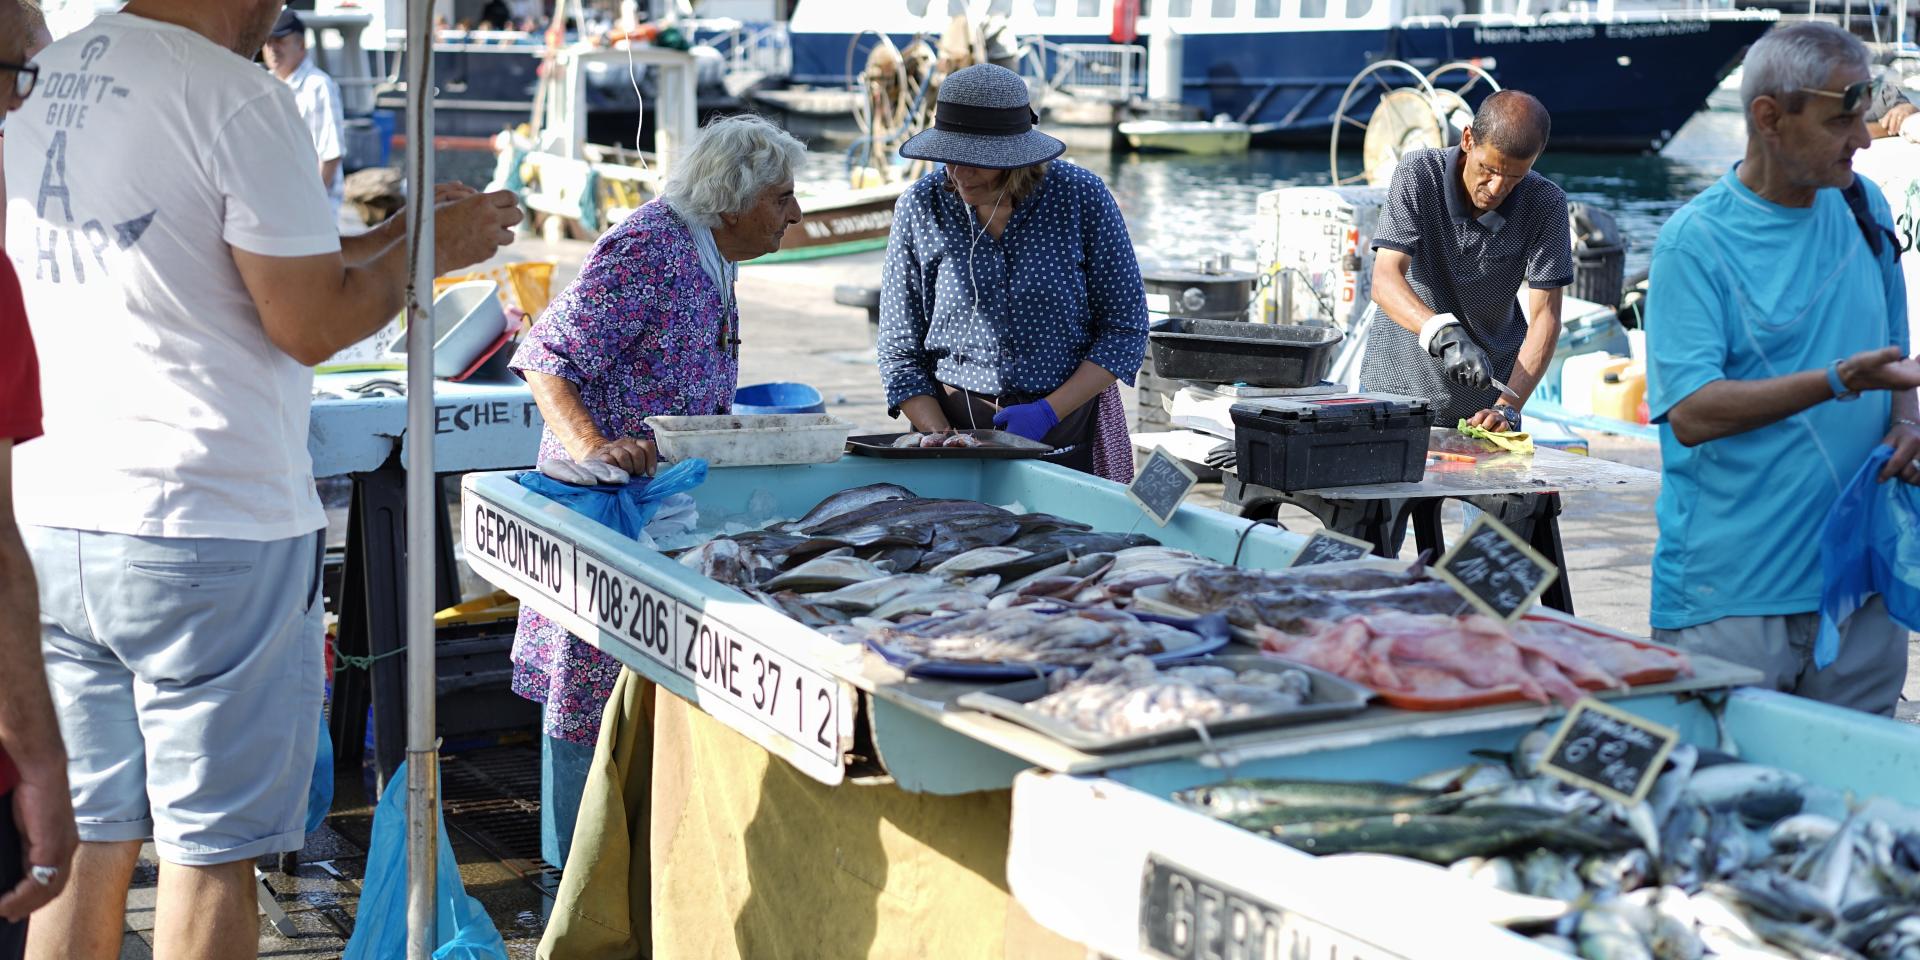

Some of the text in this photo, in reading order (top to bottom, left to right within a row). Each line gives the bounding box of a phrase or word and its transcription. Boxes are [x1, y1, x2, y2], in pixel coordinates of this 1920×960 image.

[1474, 24, 1595, 43] Henri-Jacques
[42, 71, 115, 104] DON'T
[46, 102, 88, 129] GIVE
[36, 130, 74, 222] A
[18, 219, 110, 285] HIP
[434, 402, 510, 434] ECHE
[475, 503, 563, 594] GERONIMO
[685, 613, 743, 698] ZONE
[752, 652, 782, 716] 37
